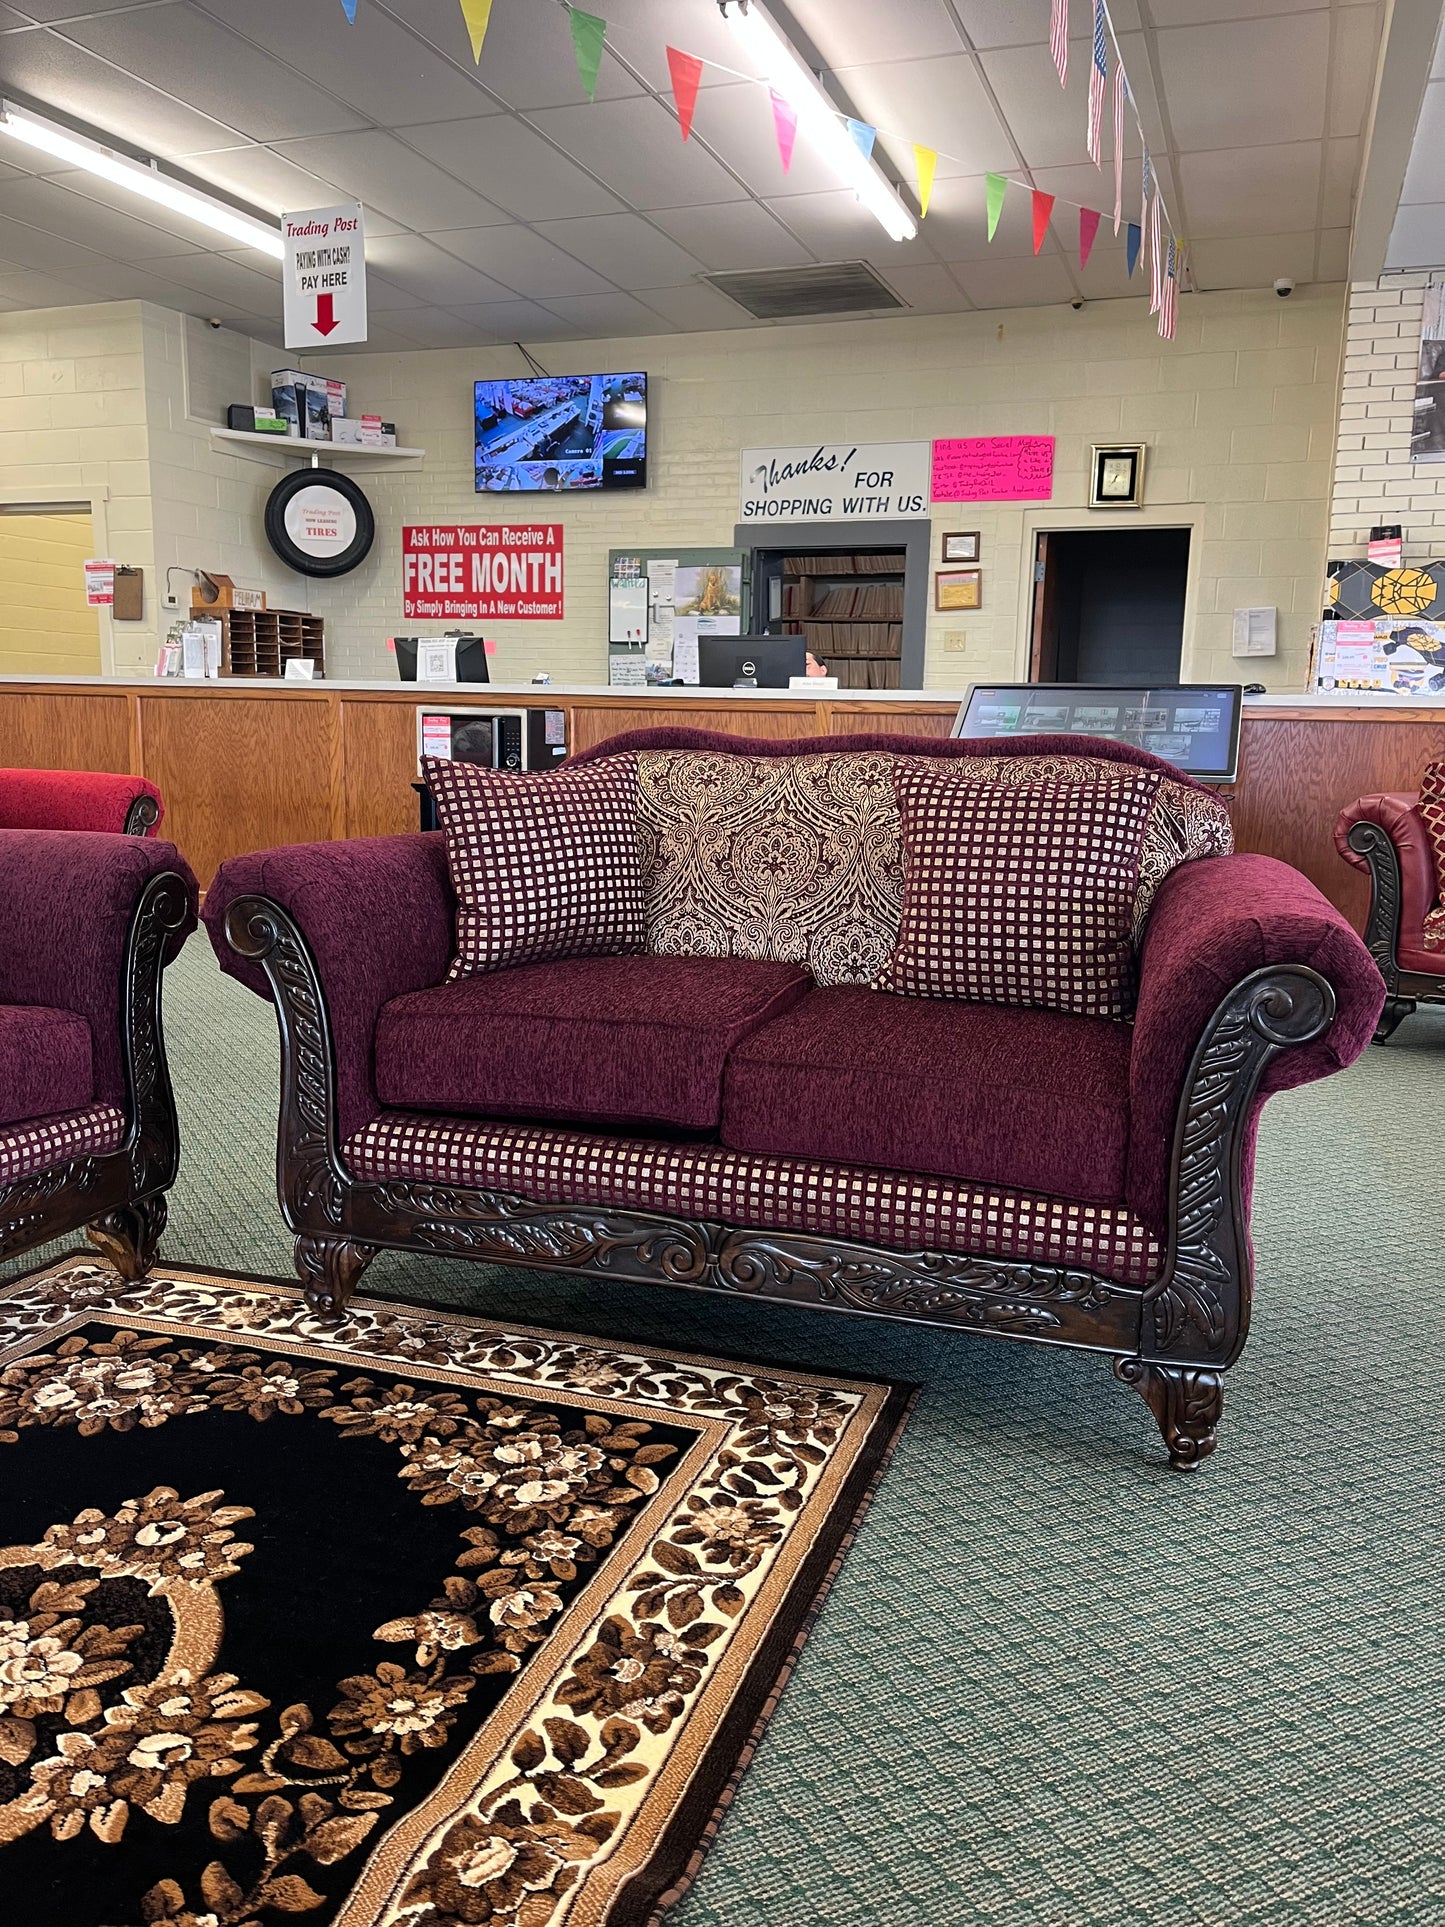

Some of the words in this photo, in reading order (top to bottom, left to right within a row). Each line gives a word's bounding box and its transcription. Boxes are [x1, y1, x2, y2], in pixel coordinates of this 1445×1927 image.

[286, 220, 329, 238] Trading
[333, 217, 358, 233] Post
[296, 250, 316, 270] PAYING
[316, 248, 332, 267] WITH
[332, 245, 351, 266] CASH?
[301, 275, 319, 290] PAY
[321, 271, 347, 288] HERE
[750, 446, 857, 493] Thanks!
[854, 471, 894, 488] FOR
[302, 508, 327, 516] Trading
[743, 498, 832, 517] SHOPPING
[843, 496, 890, 513] WITH
[897, 496, 927, 512] US.
[305, 527, 337, 537] TIRES
[410, 529, 429, 547] Ask
[432, 528, 455, 546] How
[457, 528, 476, 546] You
[479, 527, 499, 546] Can
[502, 527, 544, 545] Receive
[546, 526, 555, 545] A
[404, 553, 464, 593] FREE
[472, 552, 562, 593] MONTH
[405, 600, 414, 616] By
[417, 600, 443, 616] Simply
[445, 600, 477, 617] Bringing
[480, 600, 487, 614] In
[489, 600, 498, 614] A
[498, 600, 516, 614] New
